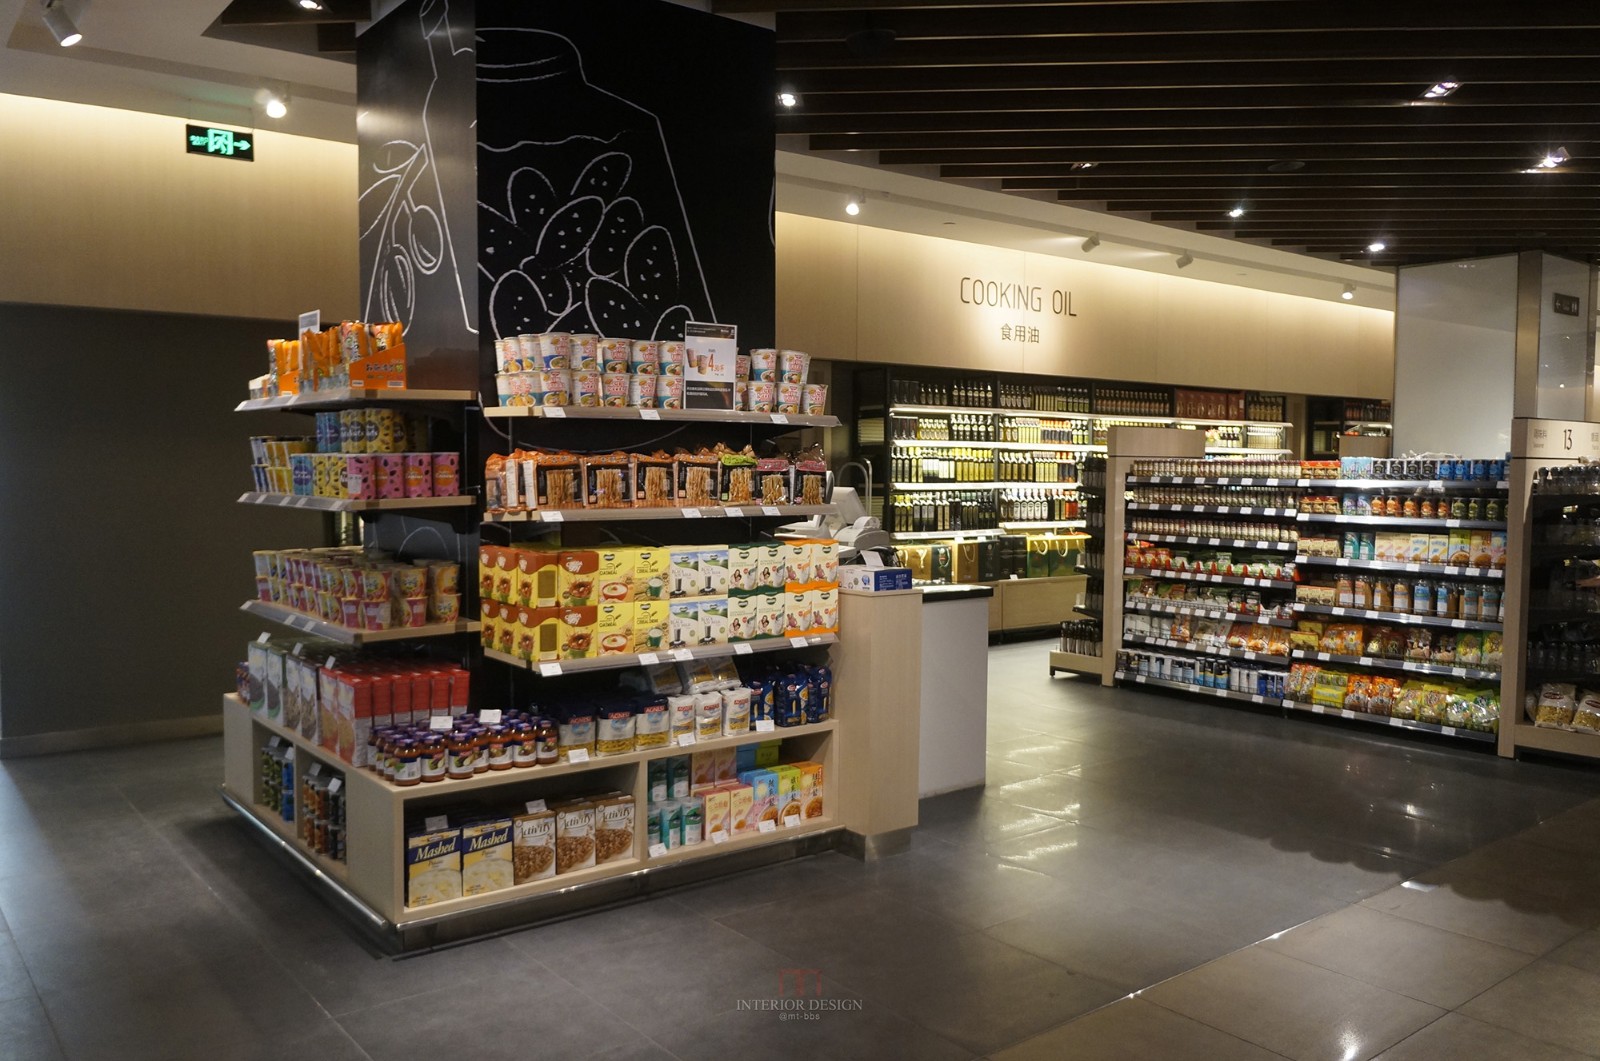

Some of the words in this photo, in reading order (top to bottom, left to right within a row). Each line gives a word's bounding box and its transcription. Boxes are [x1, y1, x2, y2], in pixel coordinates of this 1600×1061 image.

[960, 277, 1041, 312] COOKING
[1052, 290, 1077, 317] OIL
[1000, 323, 1040, 343] 食用油
[1564, 429, 1573, 450] 13
[414, 837, 457, 862] Mashed
[468, 828, 509, 852] Mashed
